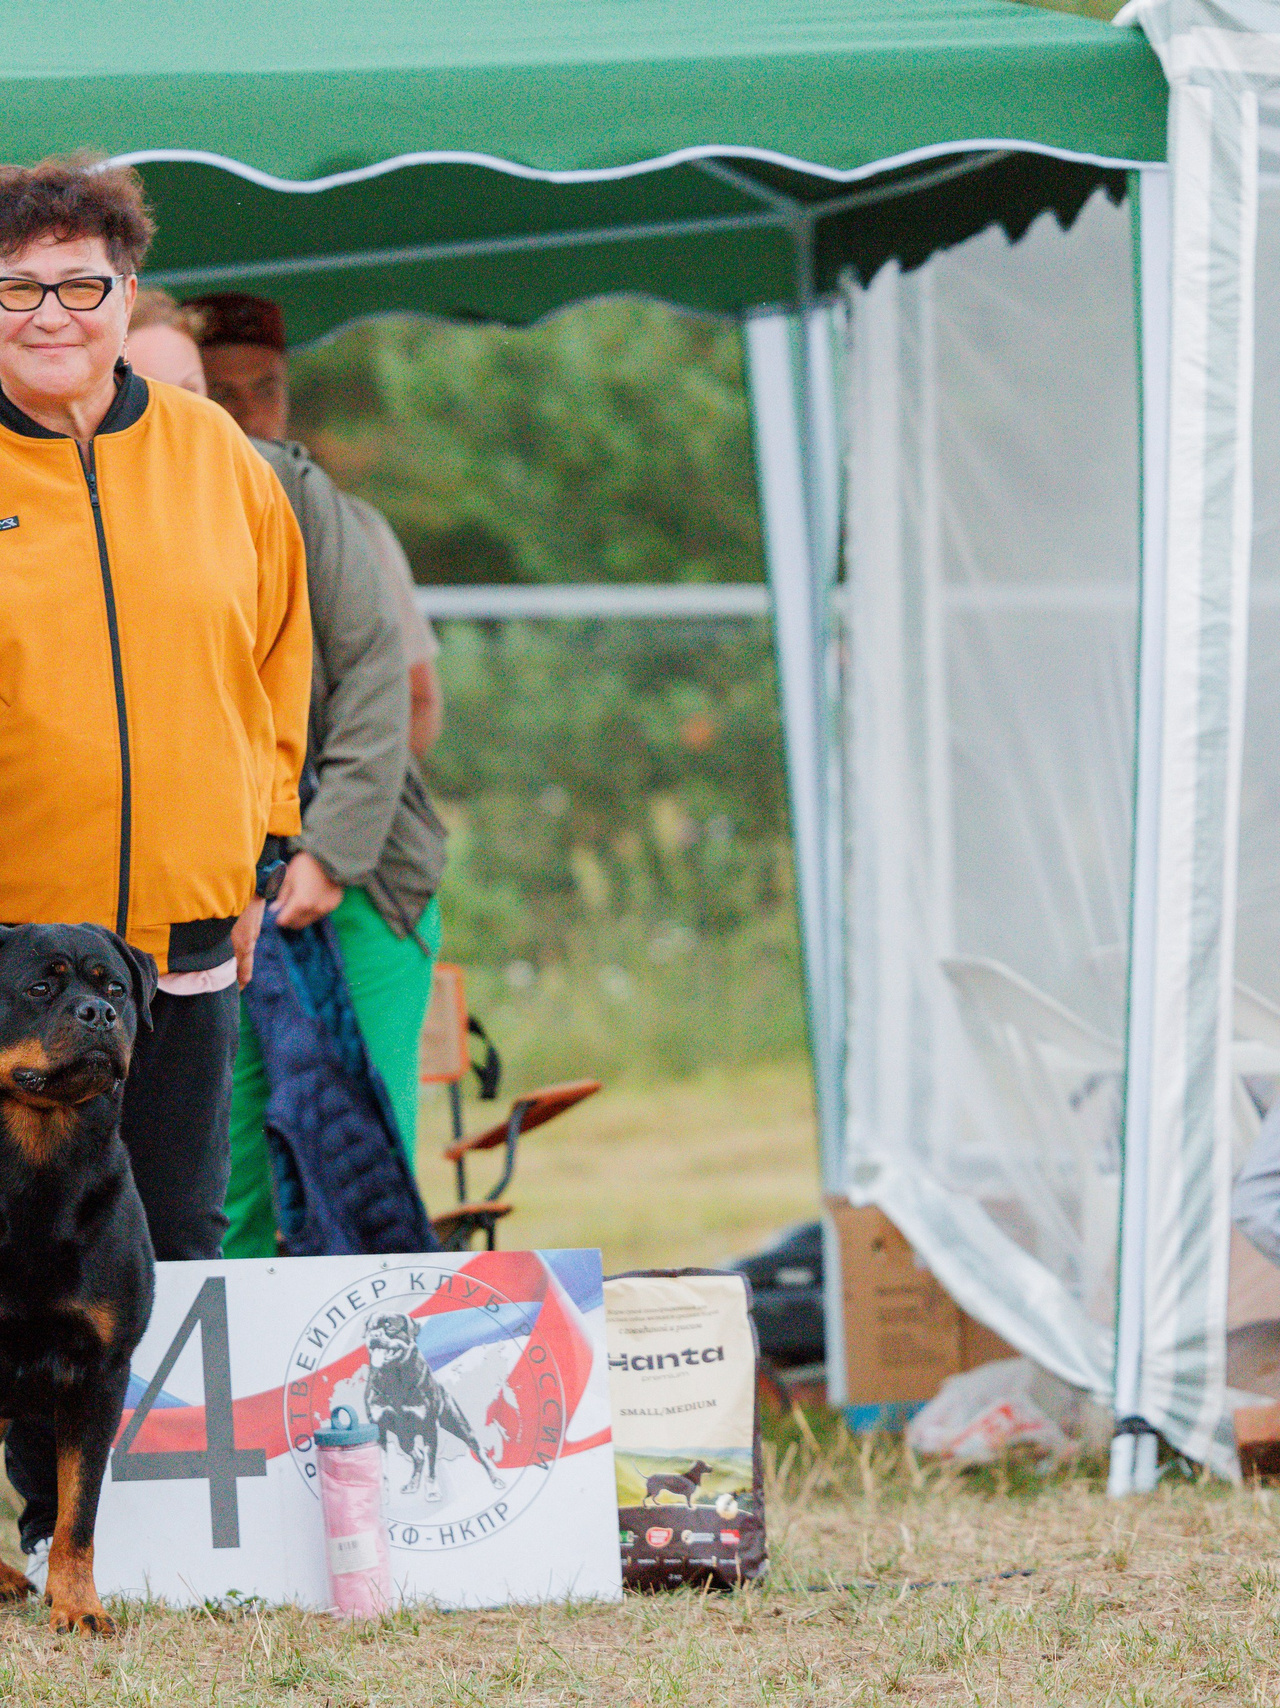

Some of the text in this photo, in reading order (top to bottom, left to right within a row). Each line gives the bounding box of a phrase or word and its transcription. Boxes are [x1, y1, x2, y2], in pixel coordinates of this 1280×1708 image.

[111, 1276, 267, 1548] 4
[290, 1272, 562, 1478] РОТВЕЙЛЕР КЛУБ РОССИИ
[608, 1345, 725, 1371] Hanta
[620, 1399, 718, 1416] SMALL/MEDIUM
